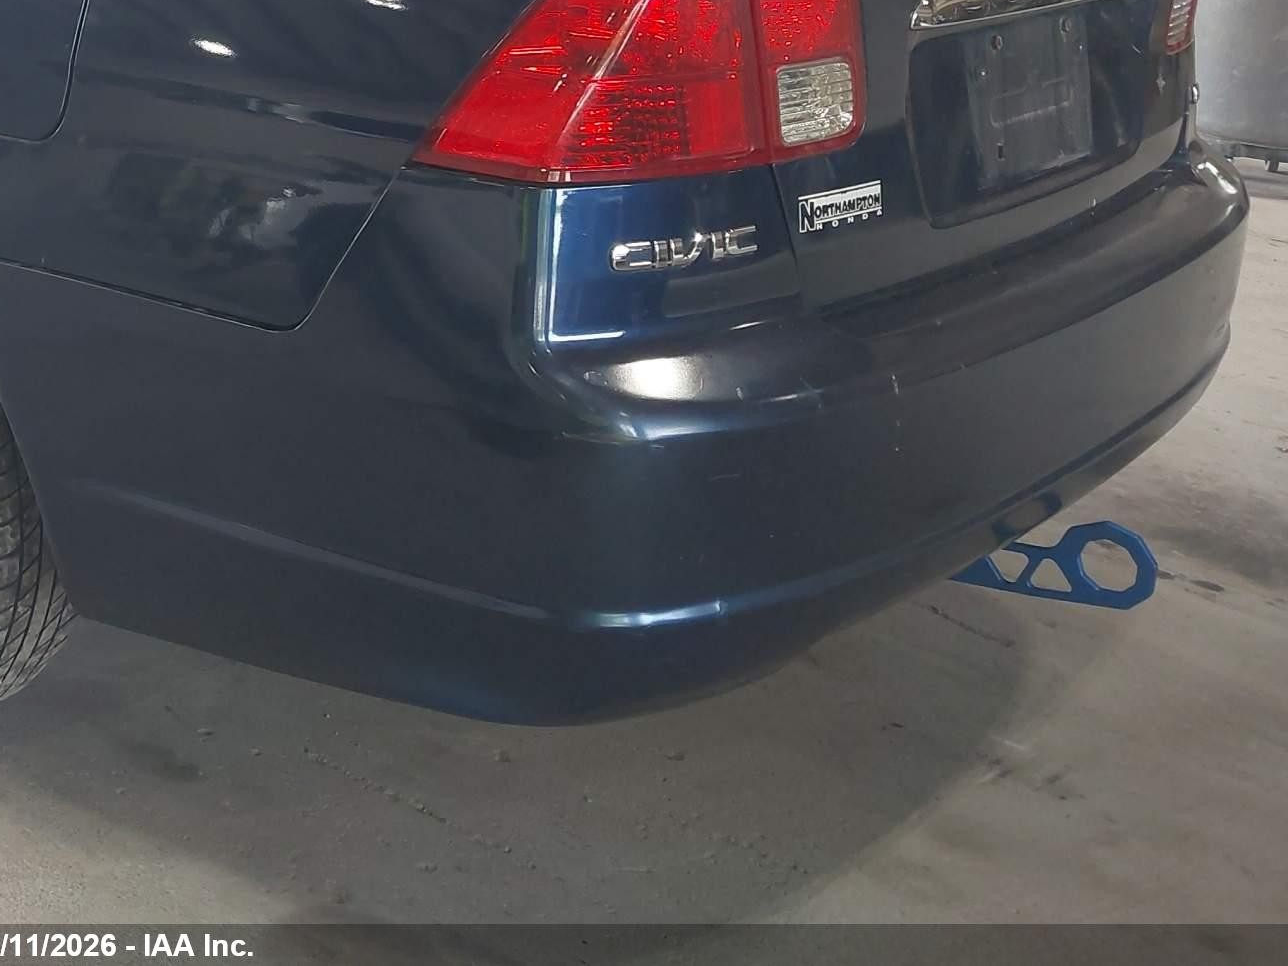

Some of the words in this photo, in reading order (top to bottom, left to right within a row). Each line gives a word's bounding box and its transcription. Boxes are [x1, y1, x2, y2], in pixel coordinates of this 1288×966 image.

[799, 193, 881, 232] NORTHAMPTON
[816, 209, 883, 230] HONDA
[611, 225, 758, 272] CIVIC
